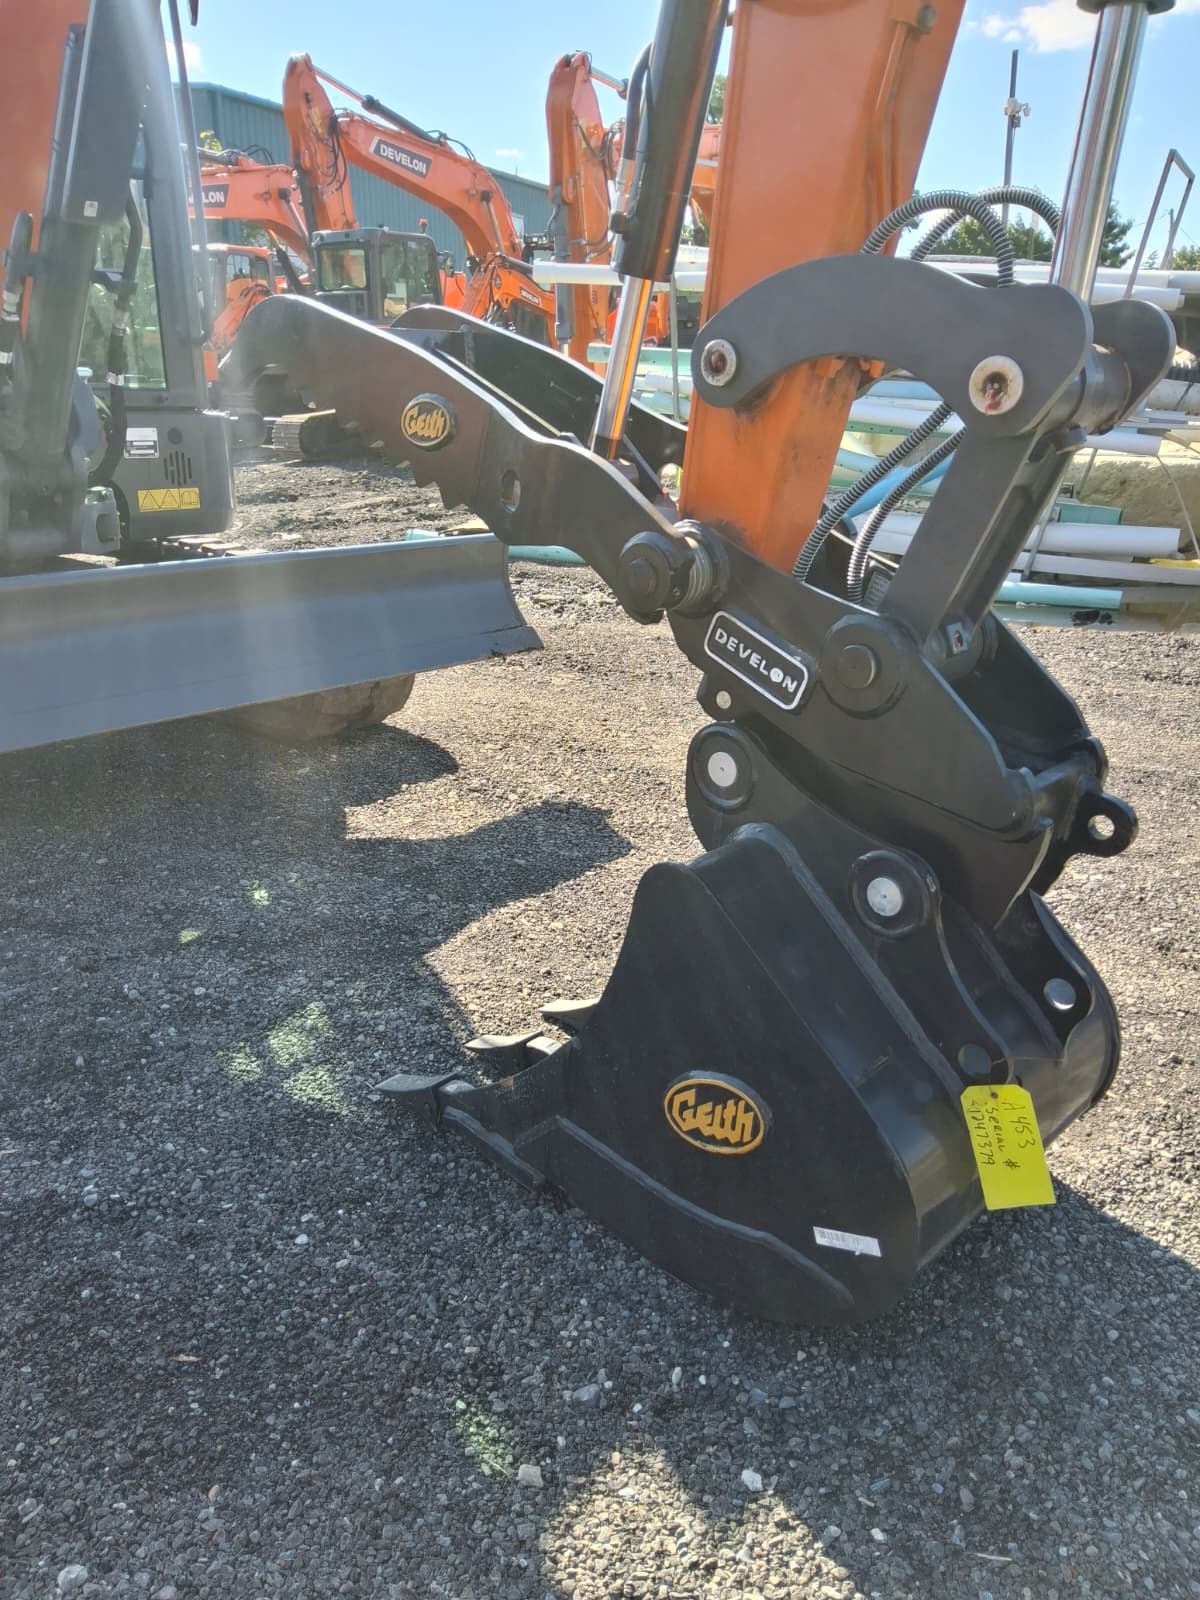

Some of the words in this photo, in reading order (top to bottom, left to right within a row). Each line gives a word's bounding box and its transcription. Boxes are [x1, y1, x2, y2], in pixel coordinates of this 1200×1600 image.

[380, 143, 427, 174] DEVELON
[714, 627, 798, 693] DEVELON
[671, 1088, 754, 1144] Geith
